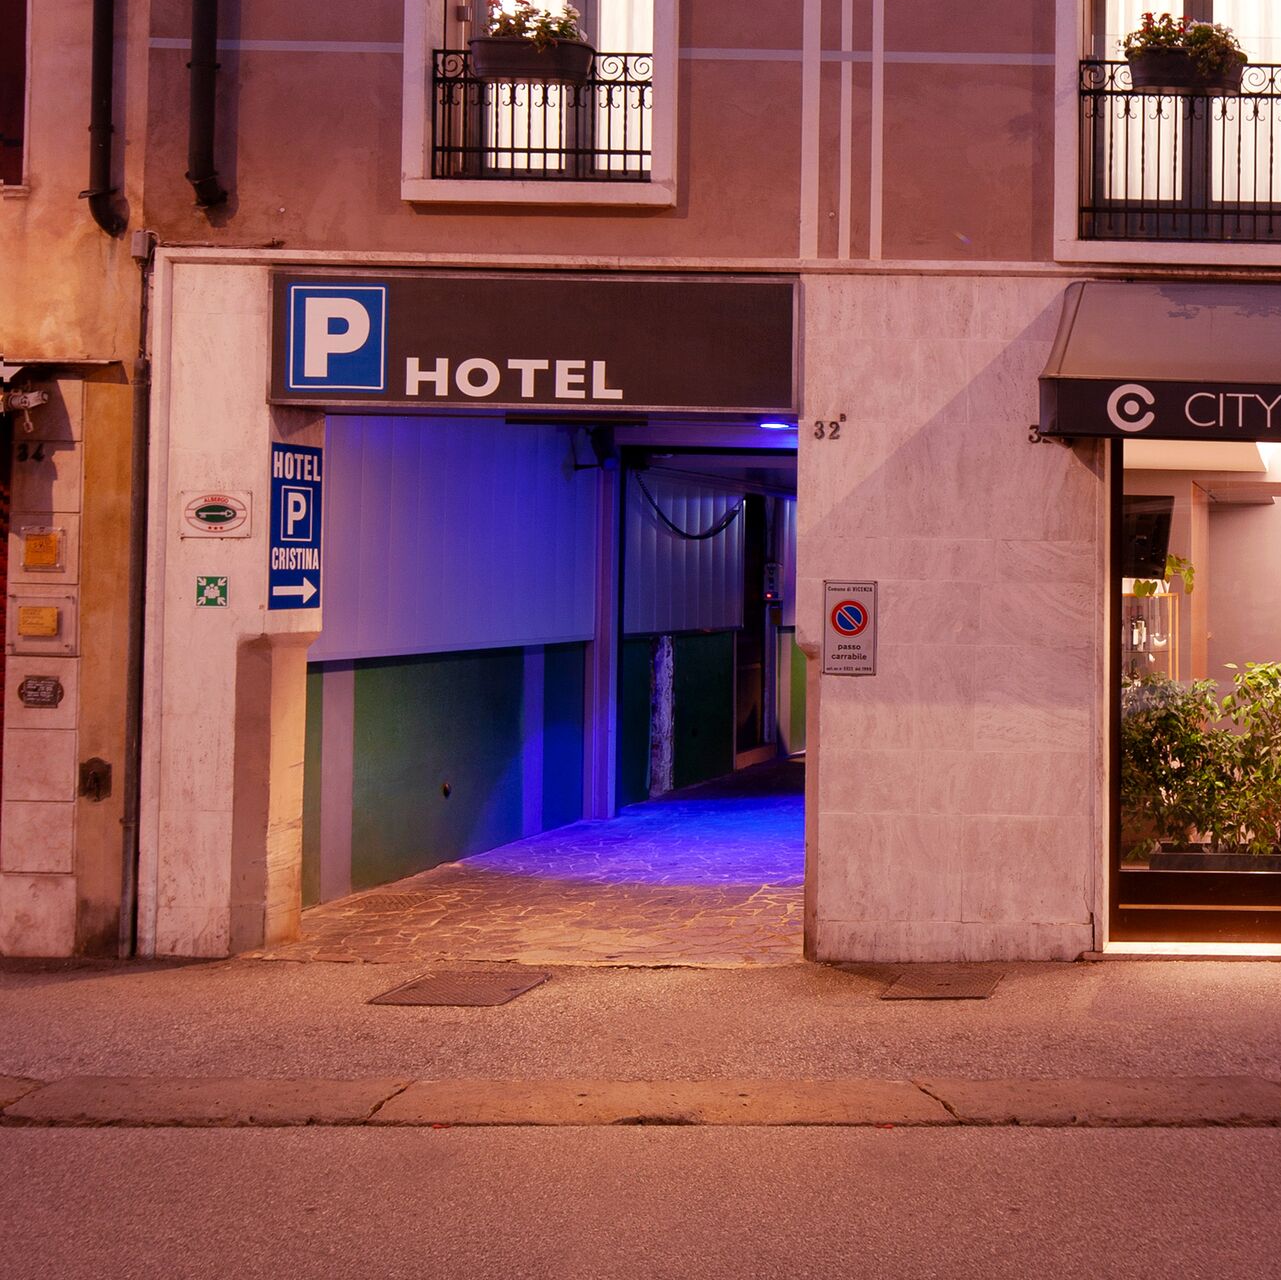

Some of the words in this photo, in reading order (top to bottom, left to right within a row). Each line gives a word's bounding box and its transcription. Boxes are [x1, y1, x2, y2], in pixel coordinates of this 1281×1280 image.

[304, 297, 371, 378] P
[405, 357, 623, 399] HOTEL
[273, 451, 321, 482] HOTEL
[287, 492, 307, 536] P
[271, 547, 320, 571] CRISTINA
